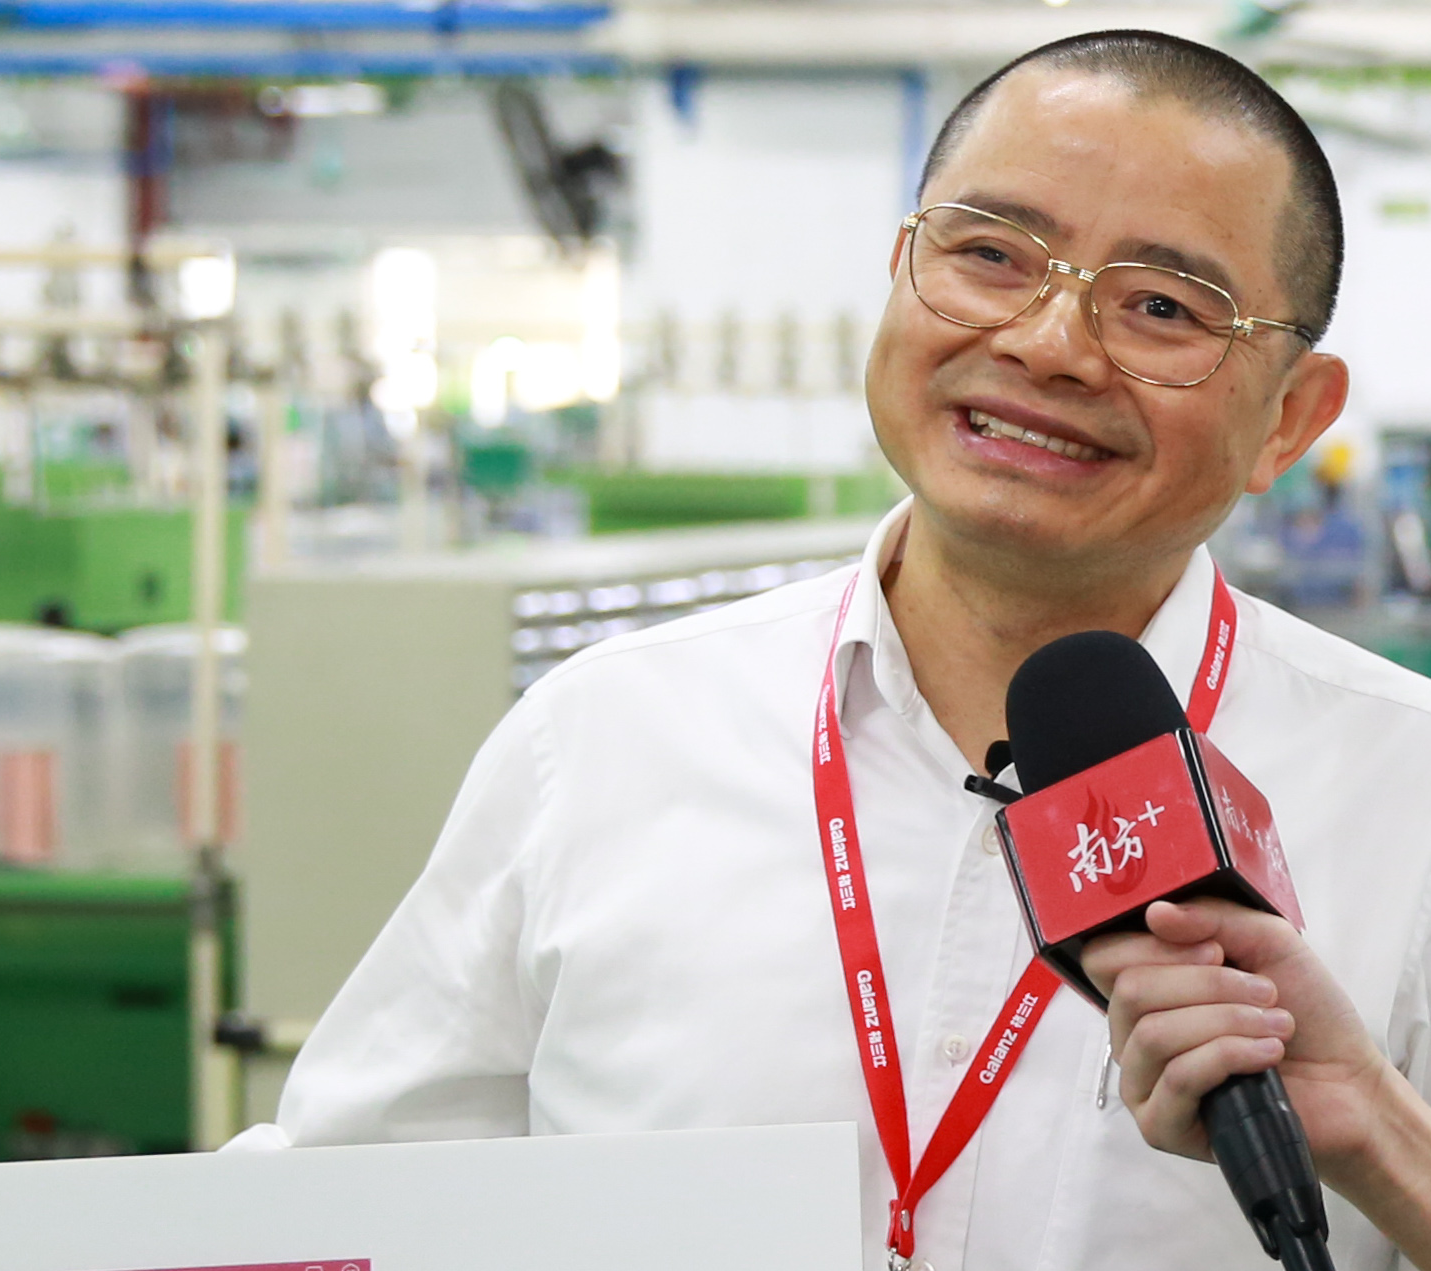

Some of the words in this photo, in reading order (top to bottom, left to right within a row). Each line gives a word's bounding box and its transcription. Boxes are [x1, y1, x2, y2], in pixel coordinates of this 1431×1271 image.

[1206, 645, 1226, 691] Galanz
[828, 817, 850, 873] Galanz
[837, 873, 857, 911] 格兰仕
[857, 969, 881, 1028] Galanz
[868, 1029, 887, 1069] 格兰仕
[979, 1028, 1019, 1085] Galanz
[1009, 992, 1039, 1029] 格兰仕
